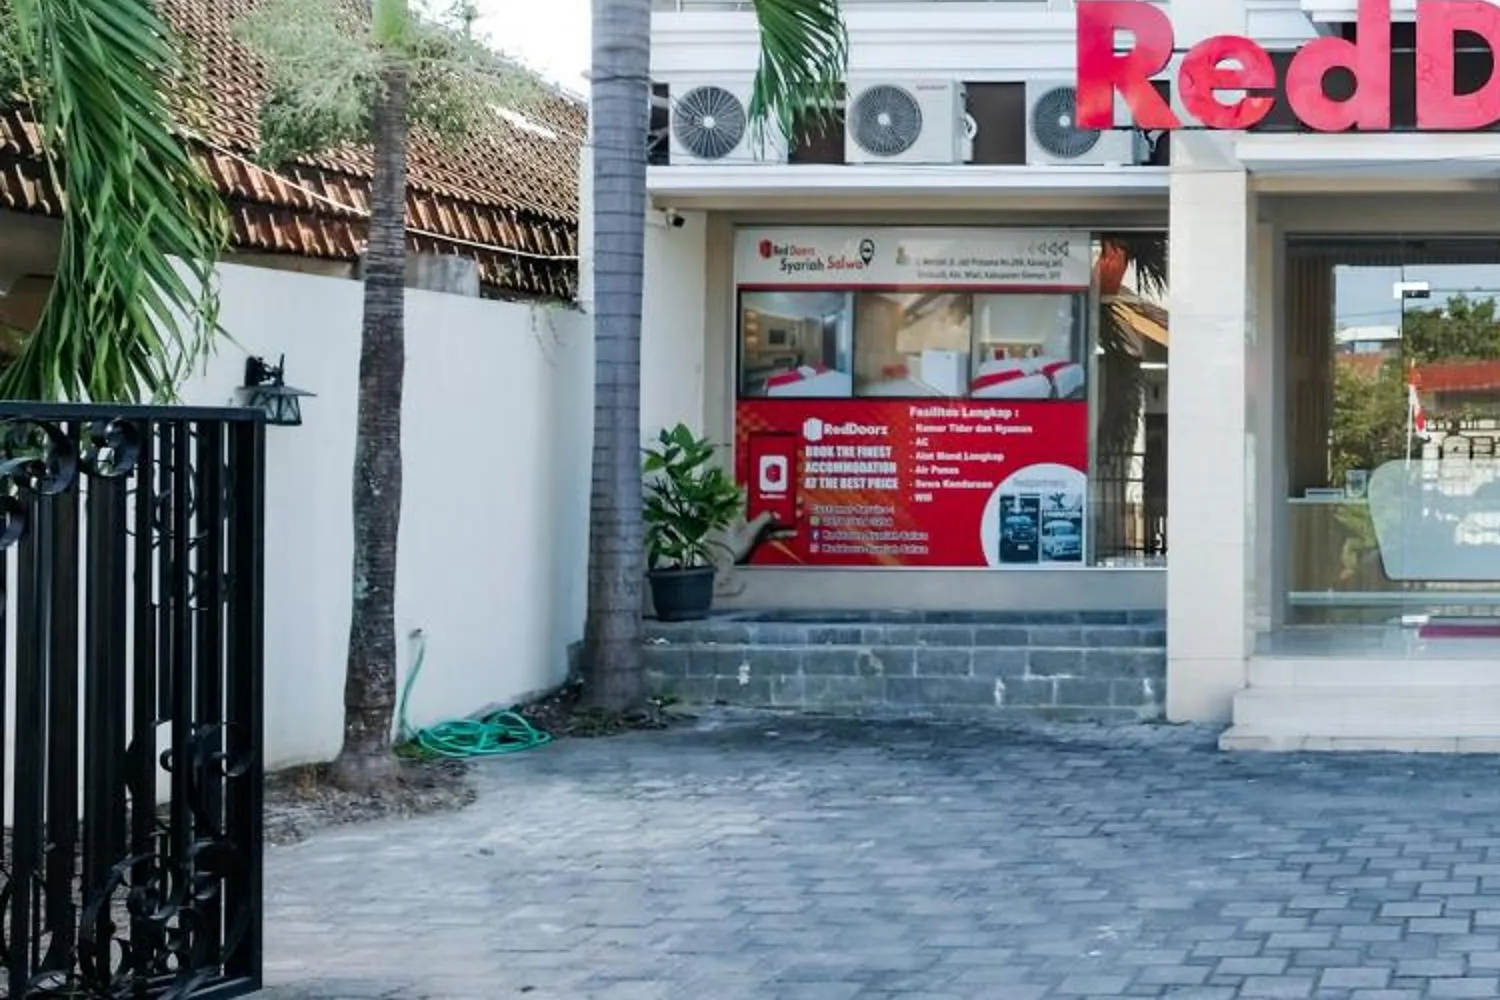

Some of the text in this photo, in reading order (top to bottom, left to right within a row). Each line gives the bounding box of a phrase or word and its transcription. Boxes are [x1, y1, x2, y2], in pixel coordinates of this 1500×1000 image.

[780, 256, 863, 275] Syariah Salwa
[961, 407, 1012, 420] Lengkap
[823, 422, 888, 436] RedDoorz
[915, 437, 928, 447] AC
[805, 445, 892, 459] BOOK THE FINEST
[819, 477, 838, 489] THE
[840, 477, 866, 489] BEST
[867, 477, 899, 489] PRICE
